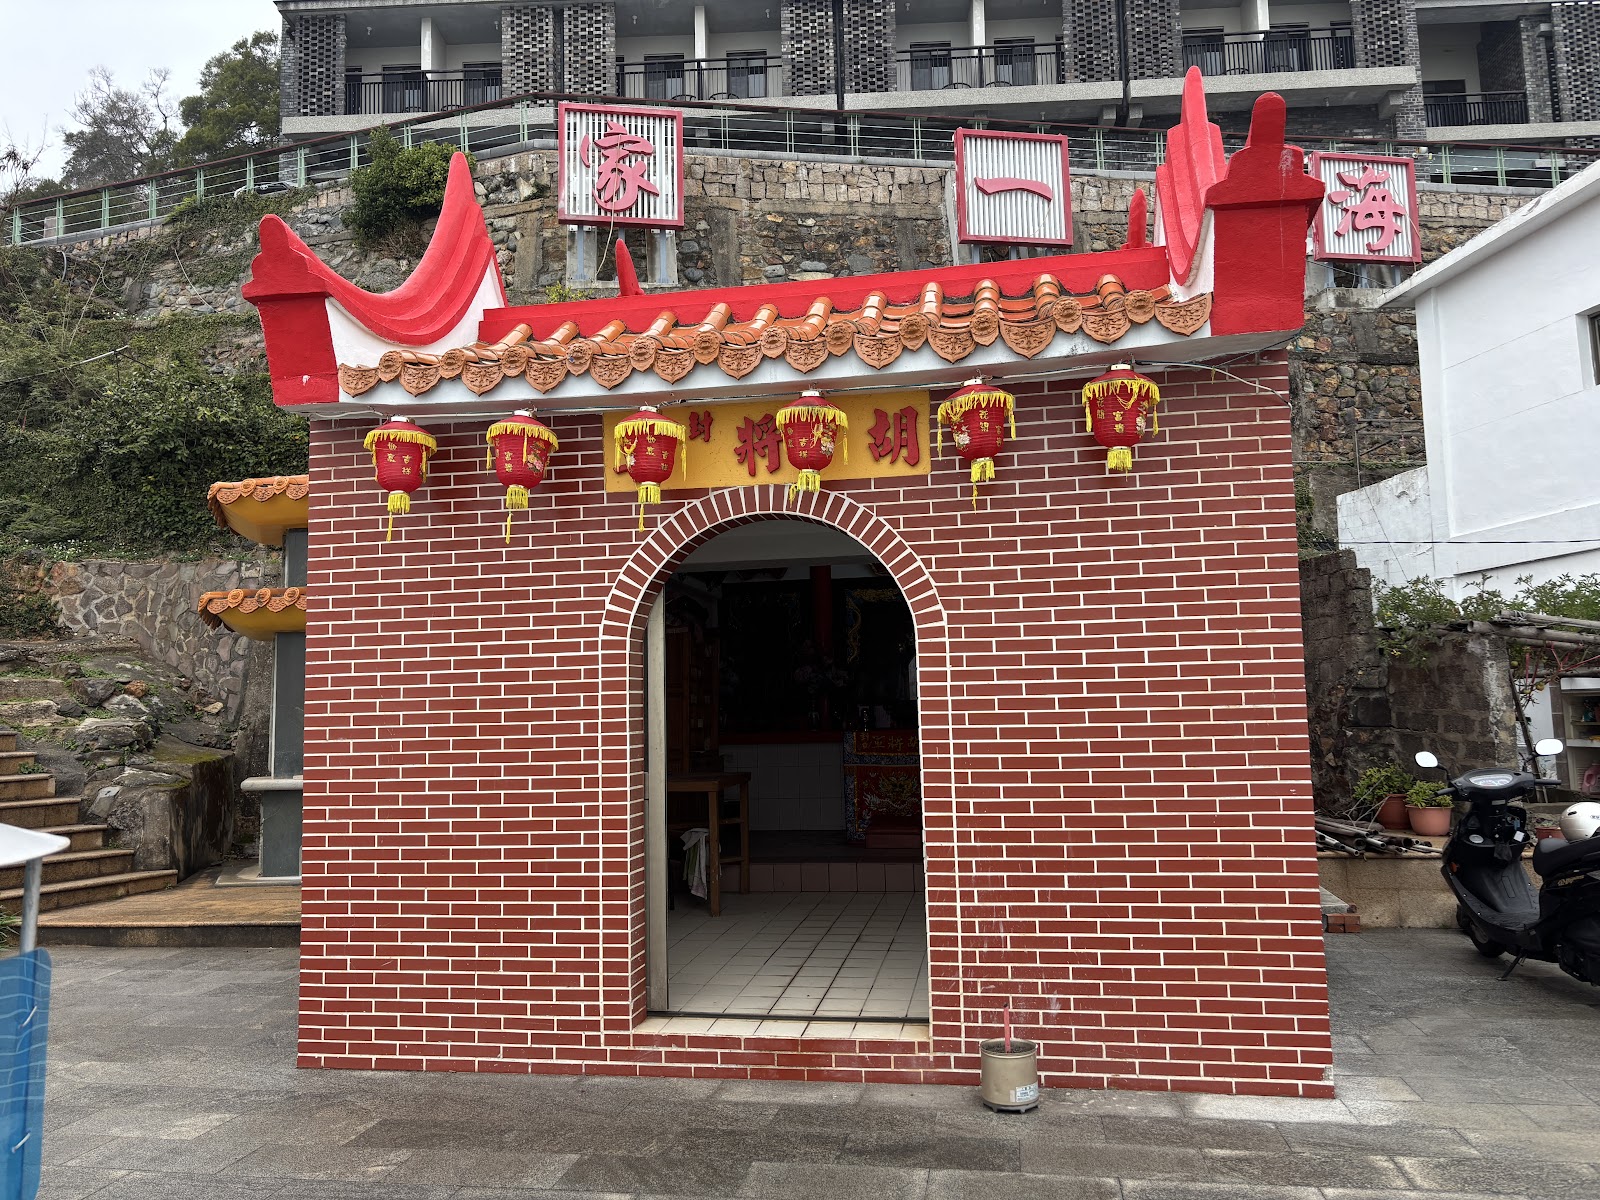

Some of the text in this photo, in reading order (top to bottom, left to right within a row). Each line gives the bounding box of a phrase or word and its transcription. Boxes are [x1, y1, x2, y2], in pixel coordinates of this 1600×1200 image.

[580, 119, 660, 213] 家
[973, 175, 1053, 203] 一
[1327, 164, 1407, 253] 海
